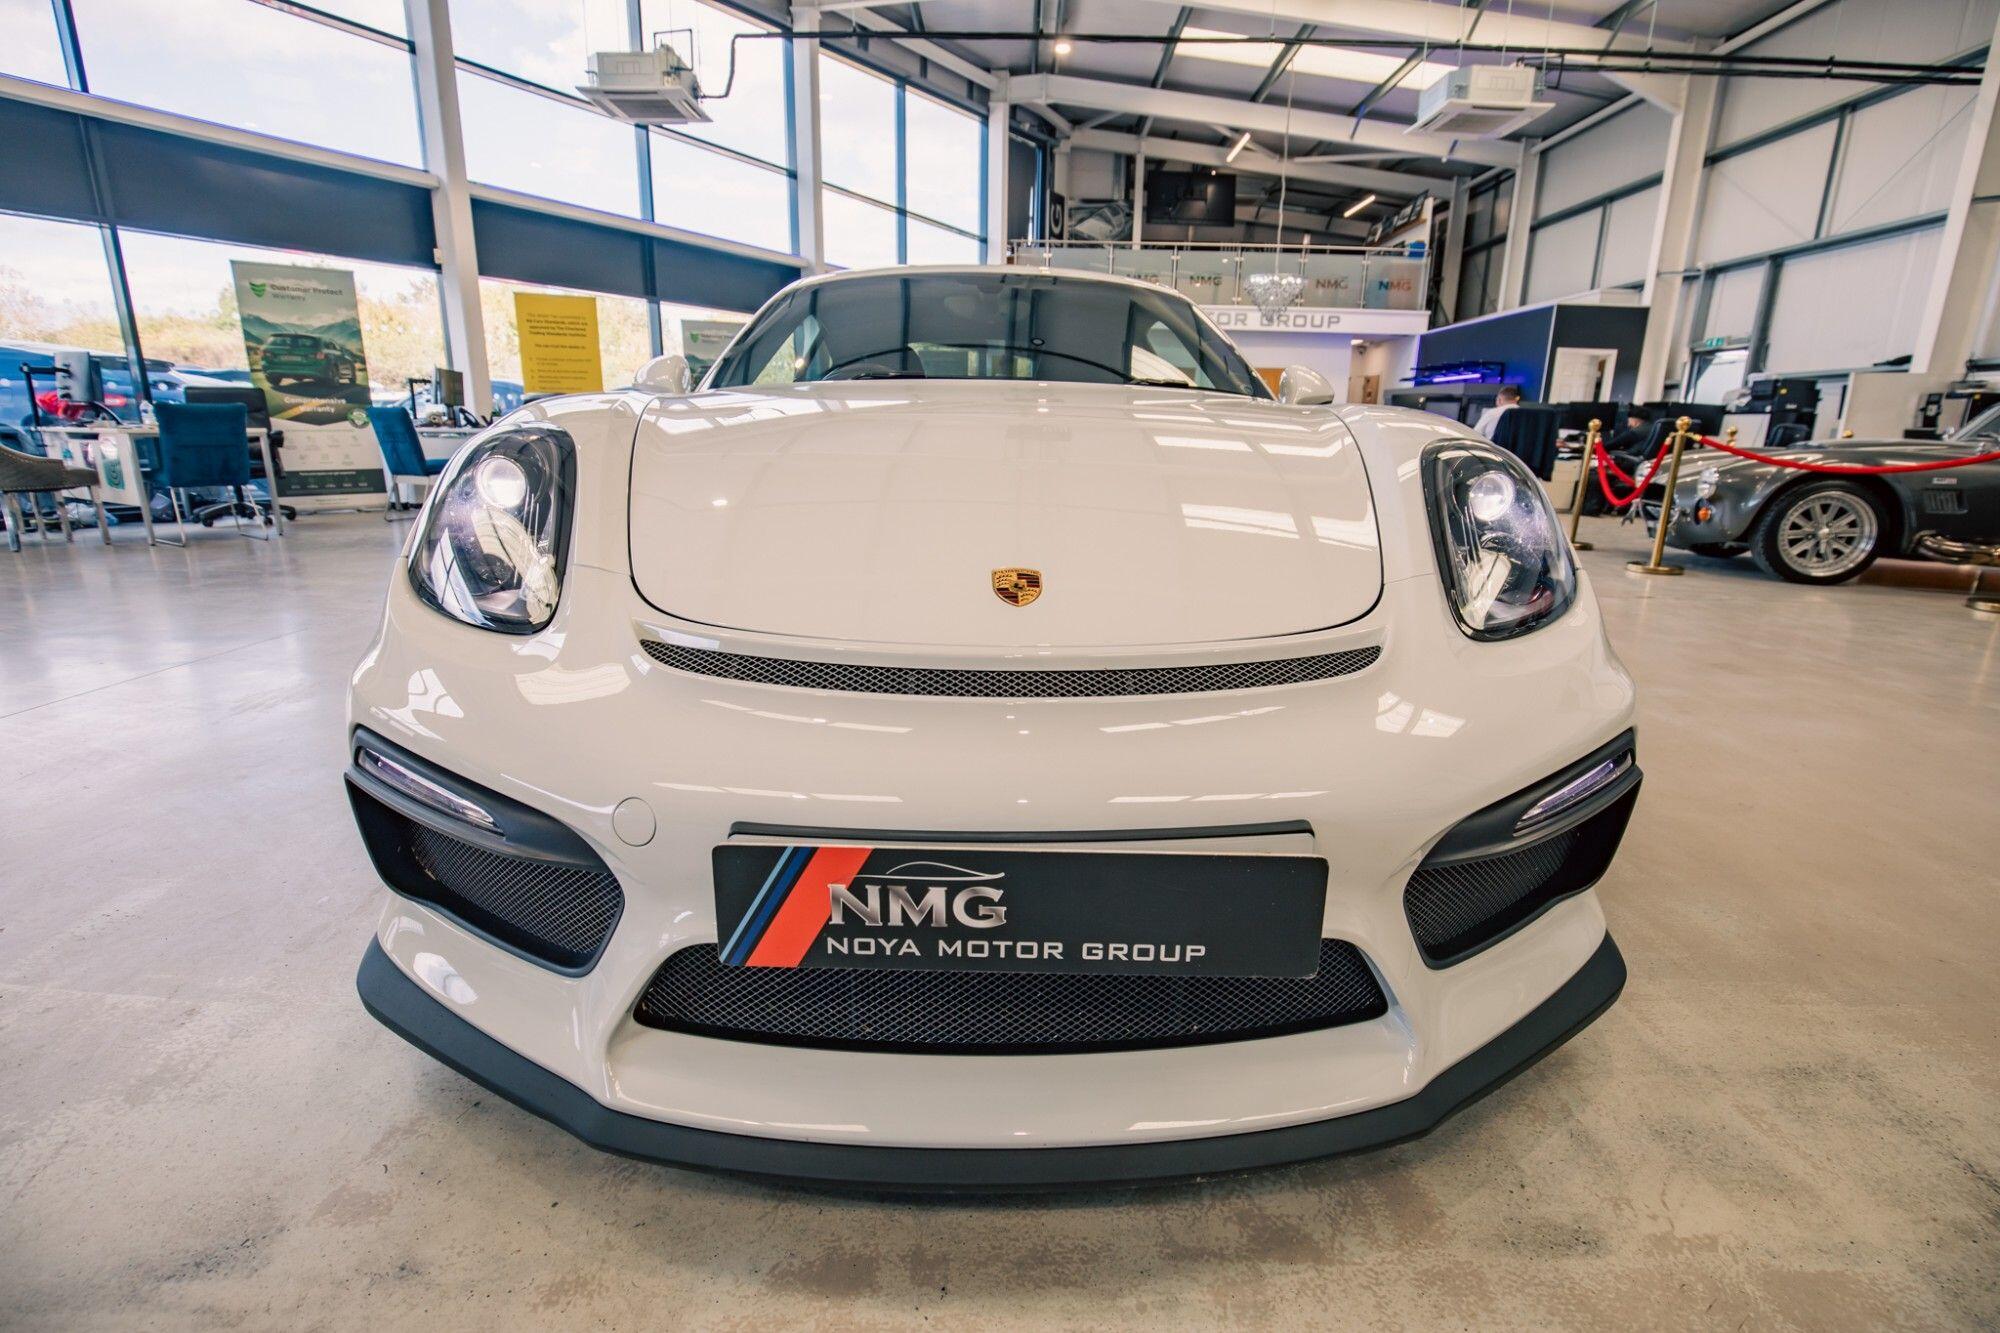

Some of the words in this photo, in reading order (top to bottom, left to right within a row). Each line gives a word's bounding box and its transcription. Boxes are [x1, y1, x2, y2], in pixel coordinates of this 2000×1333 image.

[1190, 275, 1223, 287] NMG
[1315, 278, 1349, 290] NMG
[1378, 280, 1412, 292] NMG
[270, 283, 312, 294] Customer
[313, 287, 343, 296] Protect
[827, 883, 1007, 929] NMG
[826, 936, 921, 957] NOYA
[938, 939, 1063, 960] MOTOR
[1082, 942, 1207, 962] GROUP
